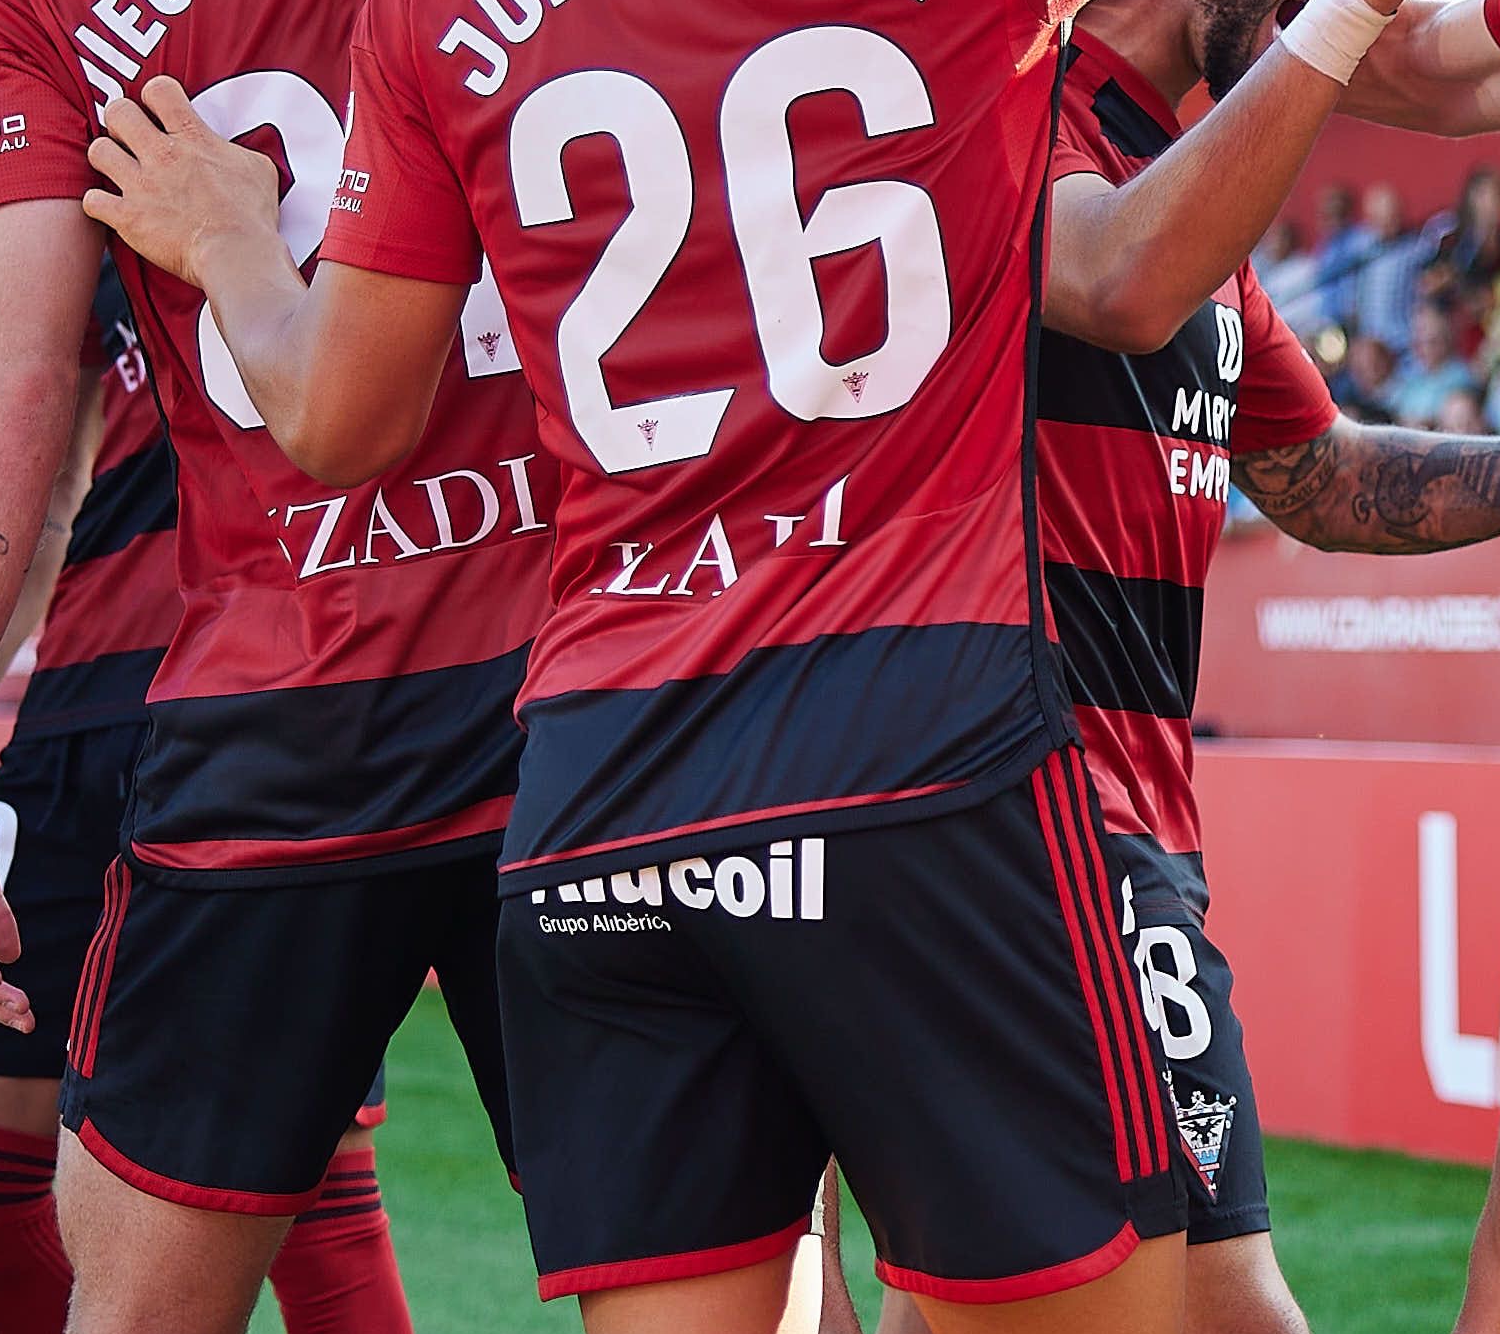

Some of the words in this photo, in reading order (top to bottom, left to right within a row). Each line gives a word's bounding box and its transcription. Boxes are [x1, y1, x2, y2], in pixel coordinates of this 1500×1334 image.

[509, 24, 953, 474] 26
[267, 453, 548, 579] ZADI
[531, 838, 825, 921] ucoil
[539, 914, 589, 935] Grupo
